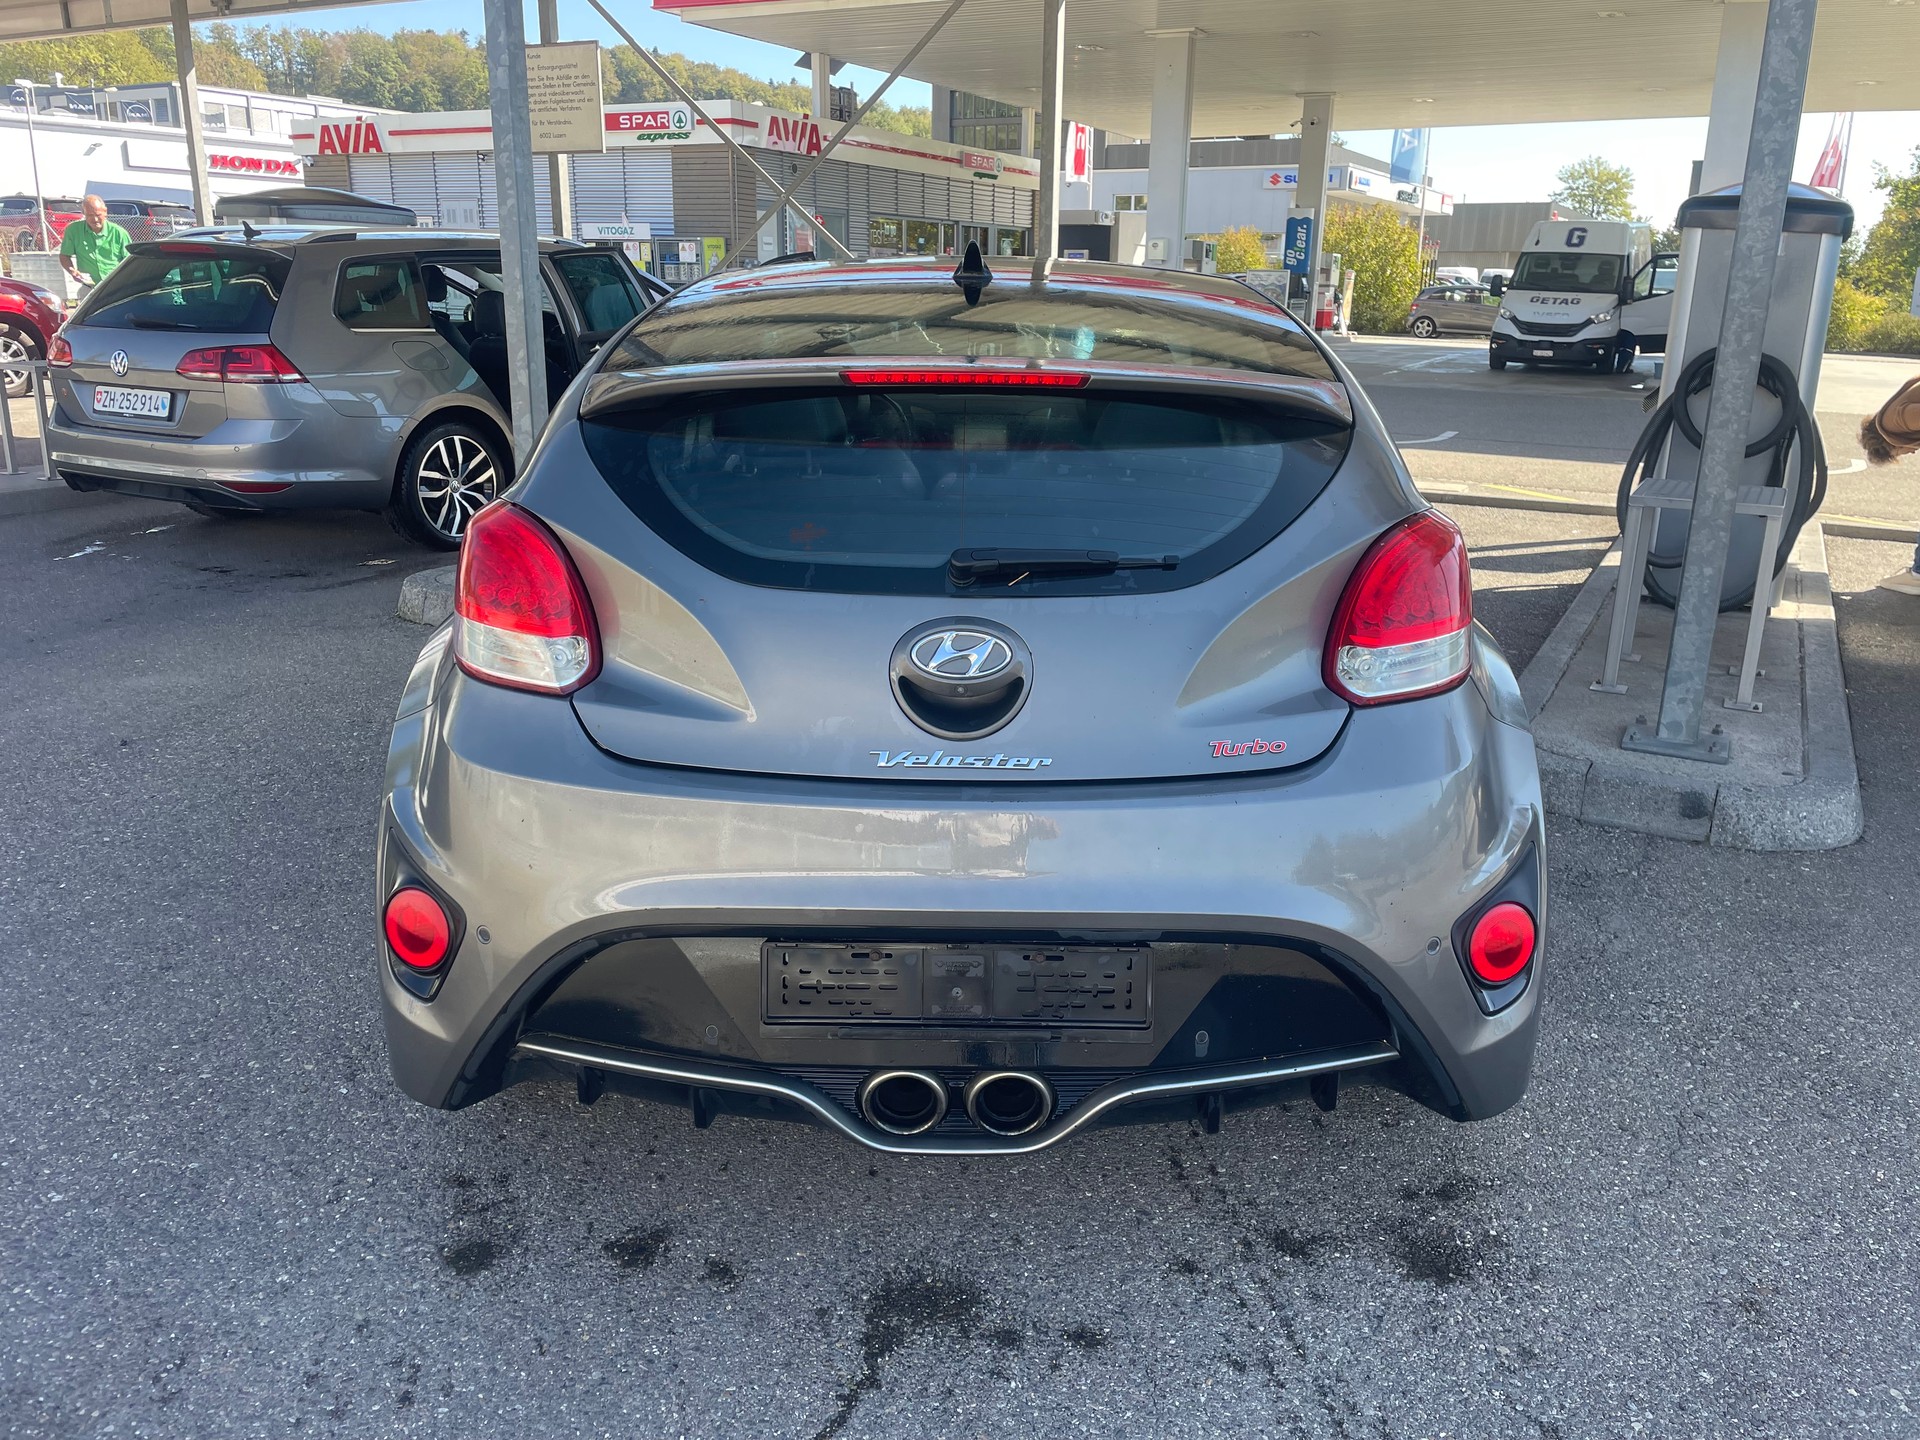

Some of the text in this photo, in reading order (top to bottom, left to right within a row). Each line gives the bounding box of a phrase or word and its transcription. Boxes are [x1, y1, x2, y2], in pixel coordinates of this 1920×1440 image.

[619, 114, 669, 128] SPAR
[637, 131, 692, 142] express
[209, 154, 300, 175] HONDA
[971, 156, 994, 170] SPAR
[1565, 227, 1589, 248] G
[1286, 249, 1297, 266] go
[1529, 296, 1582, 306] GETAG
[1209, 738, 1288, 758] Turbo
[869, 750, 1053, 770] Veloster
